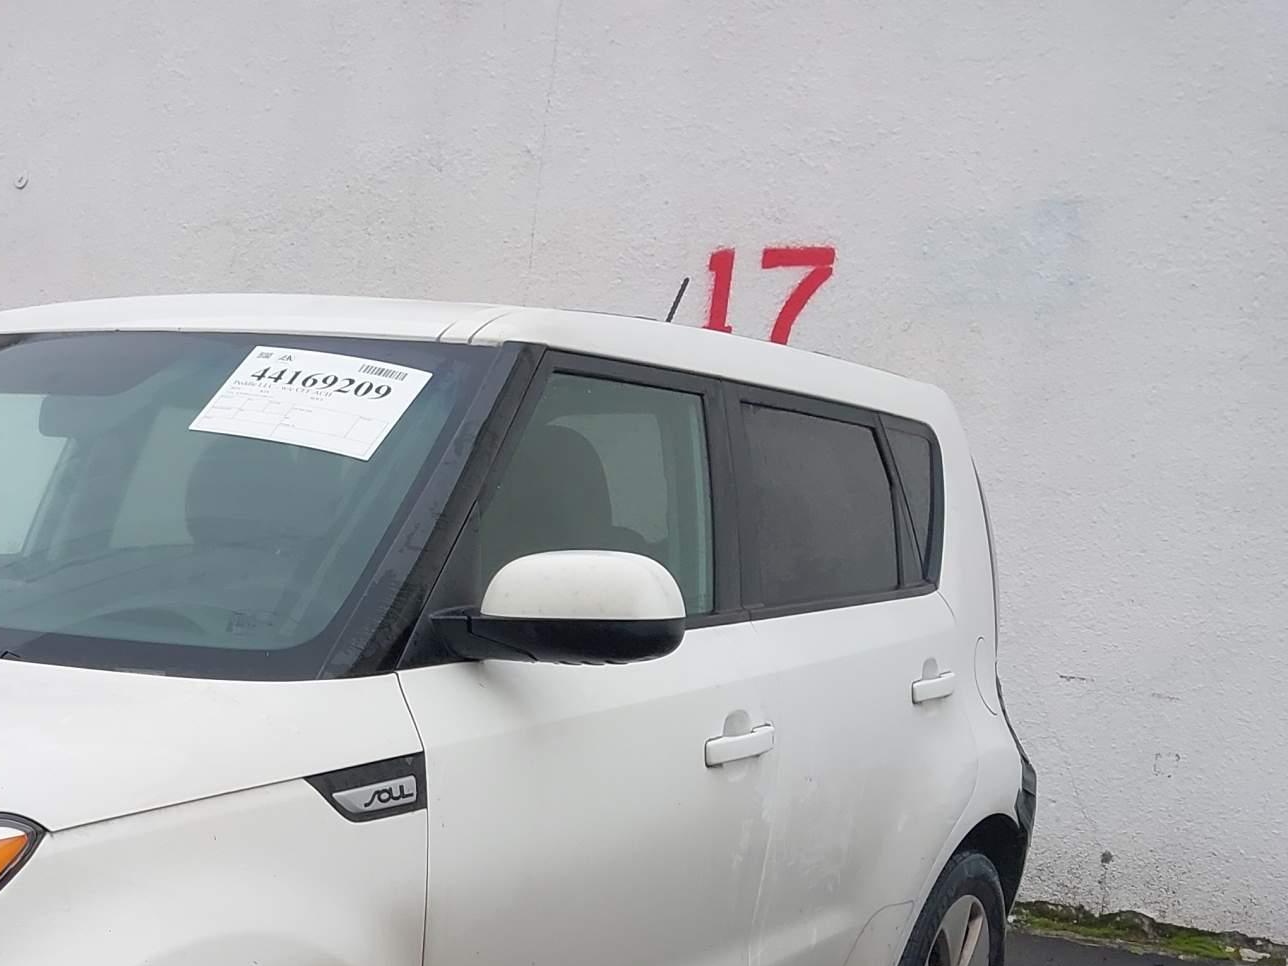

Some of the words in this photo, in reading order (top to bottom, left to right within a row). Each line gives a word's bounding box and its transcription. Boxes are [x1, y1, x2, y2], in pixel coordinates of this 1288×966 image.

[703, 245, 837, 346] 17
[251, 366, 392, 399] 44169209
[363, 785, 414, 808] SOUL
